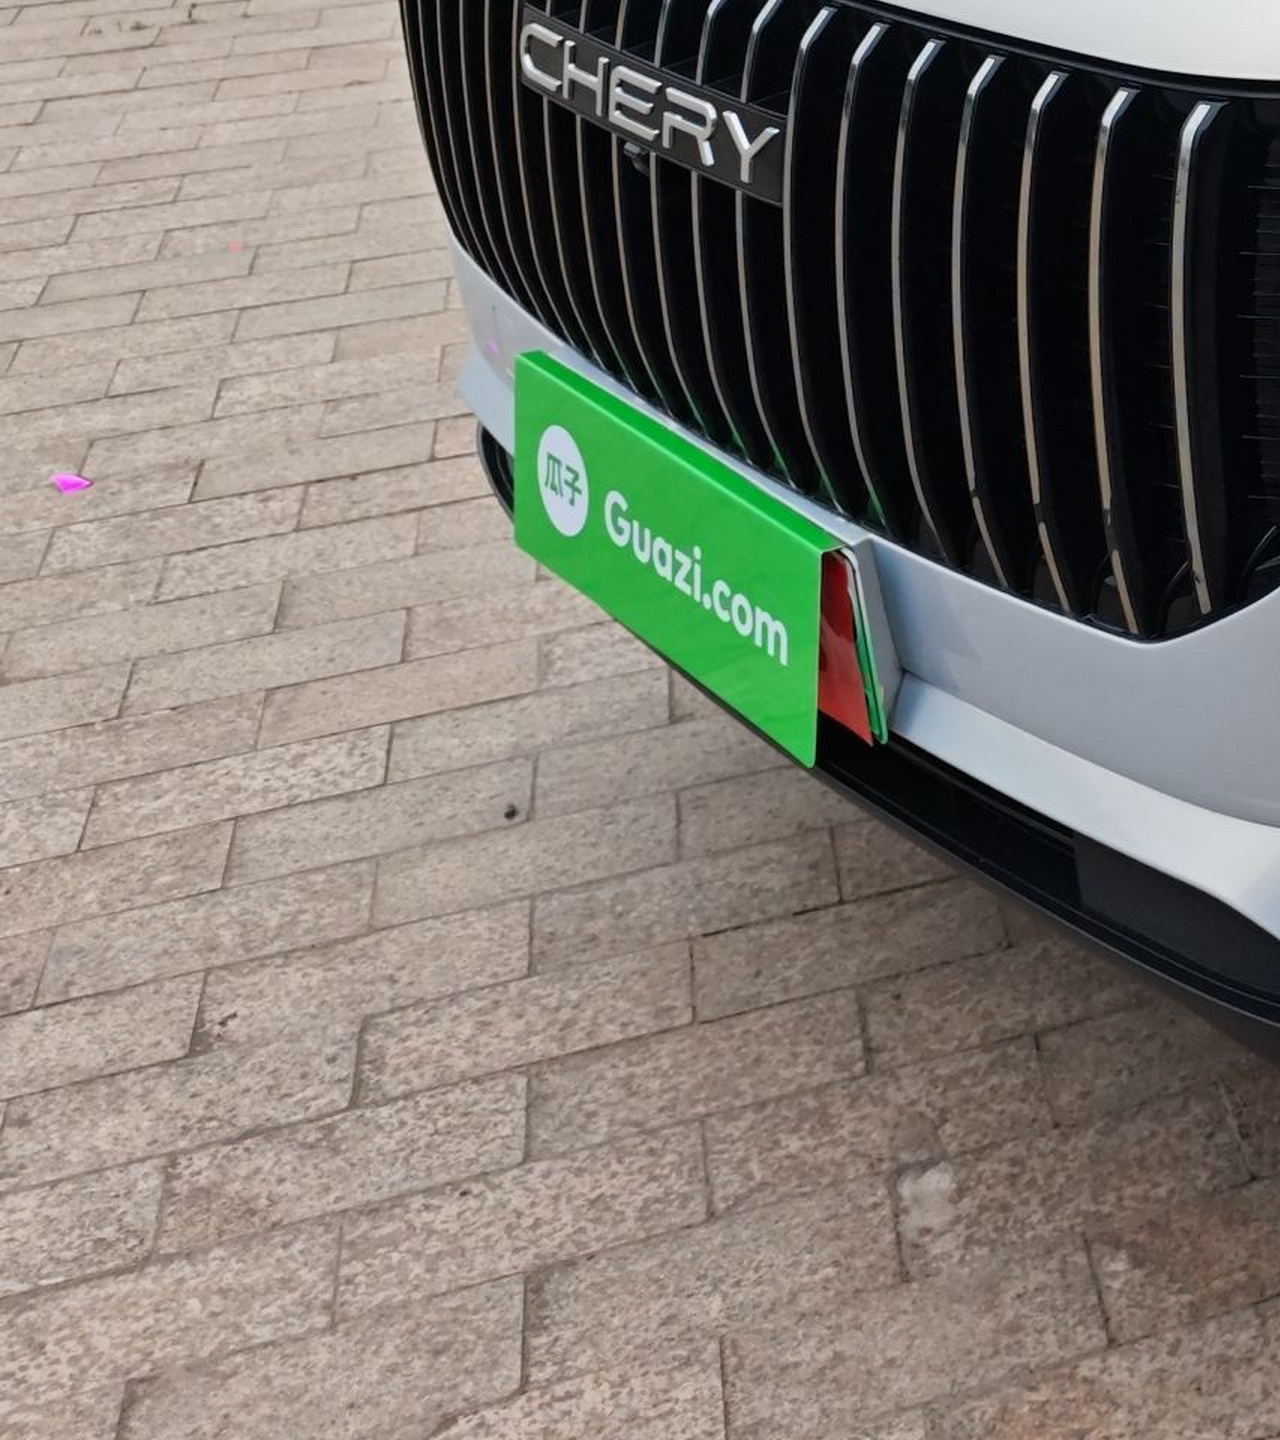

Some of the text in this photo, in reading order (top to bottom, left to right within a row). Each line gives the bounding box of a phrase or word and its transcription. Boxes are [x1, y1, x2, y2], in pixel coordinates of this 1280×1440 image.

[520, 22, 780, 184] CHERY
[544, 451, 583, 507] 瓜子
[604, 489, 788, 667] Guazi.com
